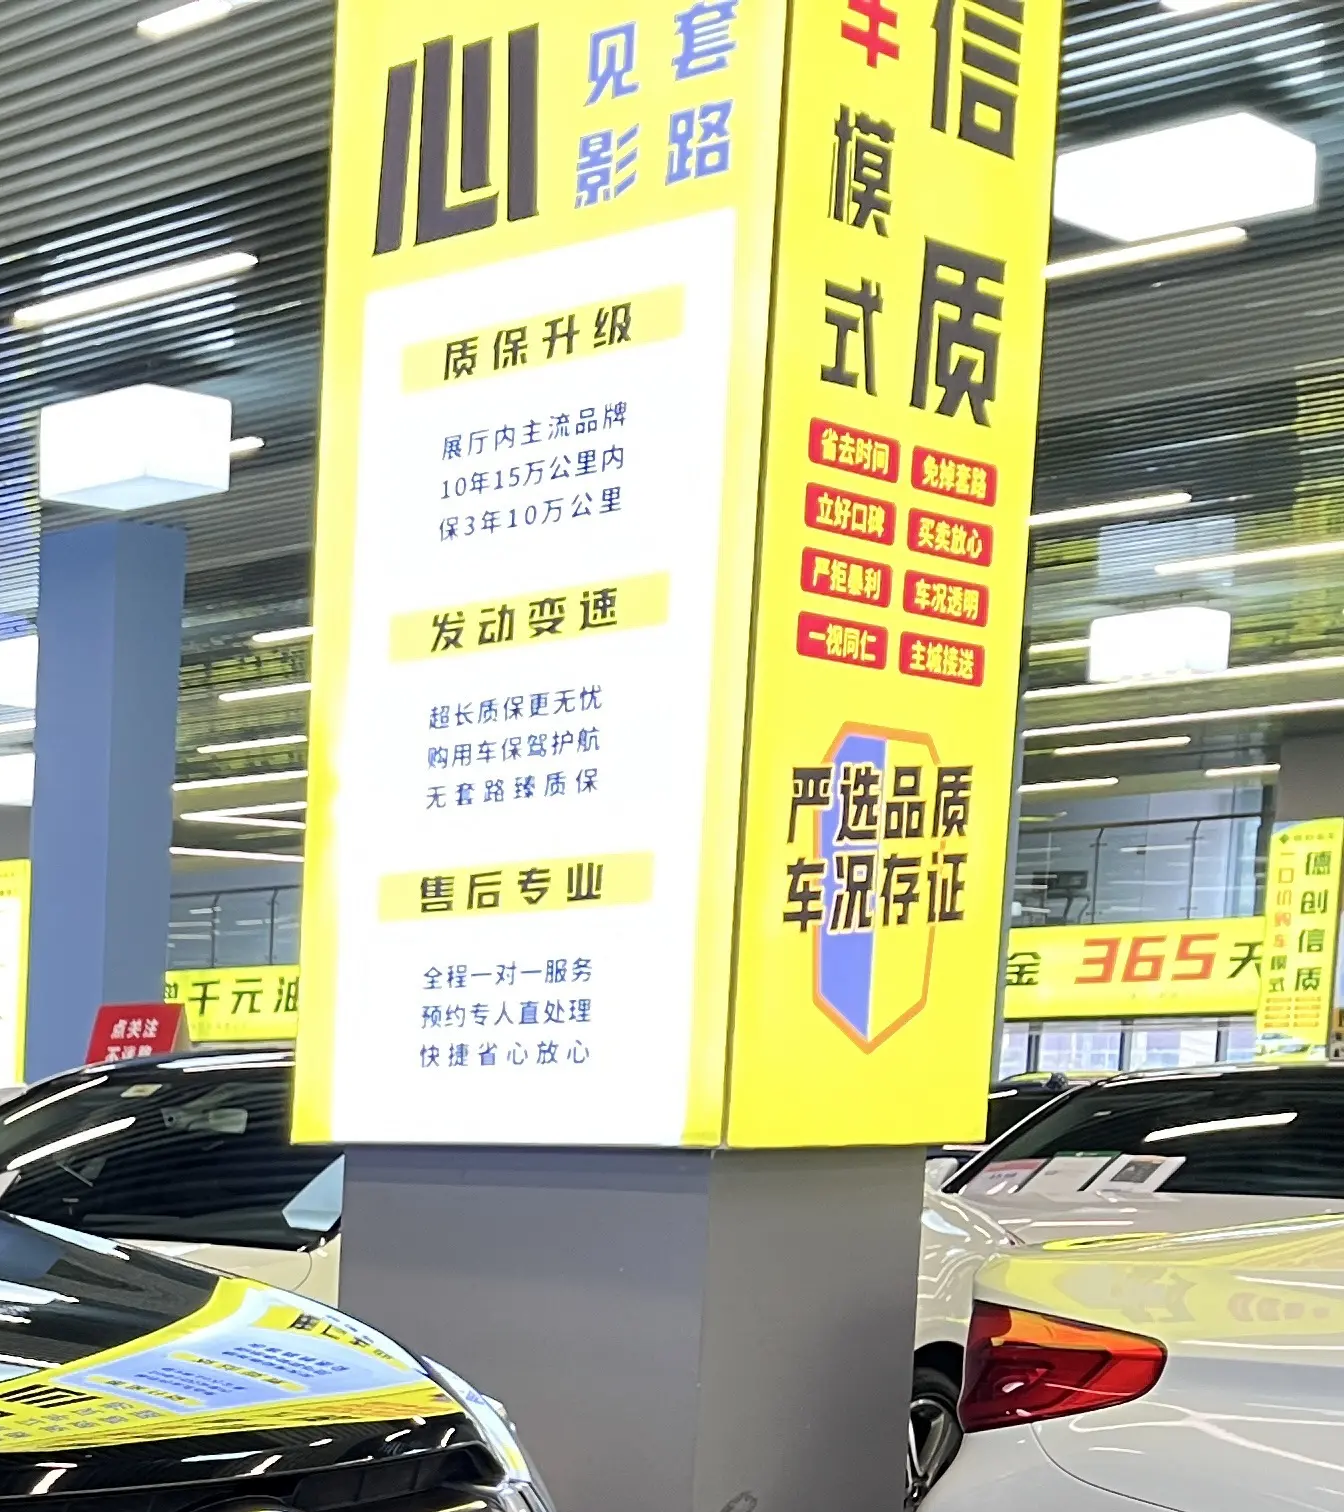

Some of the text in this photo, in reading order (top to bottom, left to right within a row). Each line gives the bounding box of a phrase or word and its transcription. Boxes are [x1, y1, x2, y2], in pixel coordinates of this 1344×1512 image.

[575, 21, 641, 210] 见影
[665, 0, 740, 186] 套路
[909, 0, 1025, 428] 信质
[443, 302, 632, 381] 质保升级
[441, 401, 628, 461] 展厅内主流品牌
[820, 427, 890, 476] 省去时间
[440, 444, 625, 500] 10年15万公里内
[921, 454, 988, 500] 免掉套路
[439, 486, 622, 542] 保3年10万公里
[815, 492, 886, 538] 立好口碑
[917, 516, 983, 559] 买卖放心
[812, 556, 882, 601] 严拒暴利
[913, 578, 980, 621] 车况透明
[430, 587, 618, 653] 发动变速
[808, 622, 877, 662] 一视同仁
[908, 639, 975, 680] 主城接送
[428, 684, 603, 730] 超长质保更无忧
[427, 725, 601, 769] 购用车保驾护航
[425, 767, 599, 811] 无套路臻质保
[786, 765, 974, 844] 严选品质
[420, 862, 604, 913] 售后专业
[782, 852, 968, 933] 车况存证
[422, 957, 593, 990] 全程一对一服务
[110, 1018, 159, 1040] 点关注
[420, 998, 592, 1029] 预约专人直处理
[419, 1039, 590, 1068] 快捷省心放心
